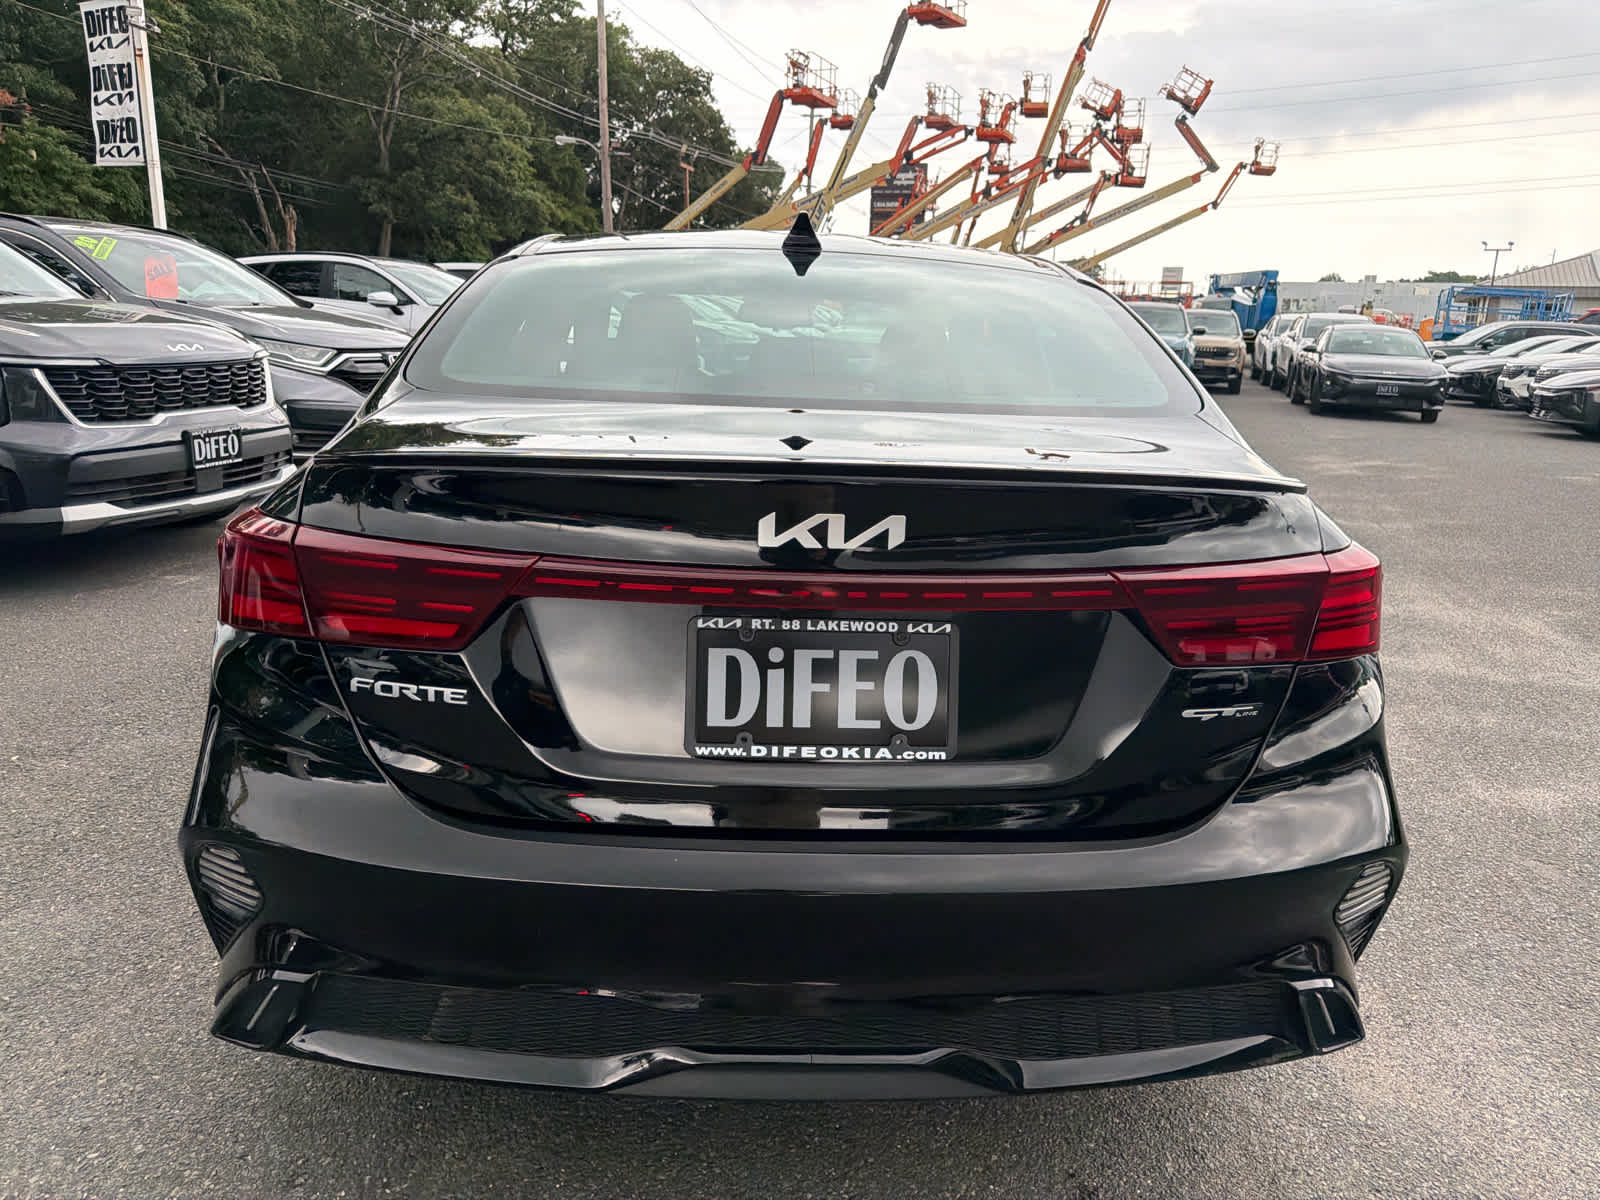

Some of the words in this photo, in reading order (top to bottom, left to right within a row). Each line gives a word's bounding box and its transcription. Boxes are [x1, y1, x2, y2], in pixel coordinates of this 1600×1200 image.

[193, 433, 239, 461] DiFEO
[758, 511, 906, 550] KIA
[697, 617, 742, 629] KIA
[751, 619, 775, 630] RT.
[782, 620, 800, 630] 88
[806, 620, 898, 632] LAKEWOOD
[907, 622, 951, 633] KIA
[350, 677, 468, 704] FORTE
[707, 647, 938, 731] DiFEO
[695, 745, 946, 760] www.DIFEOKIA.com
